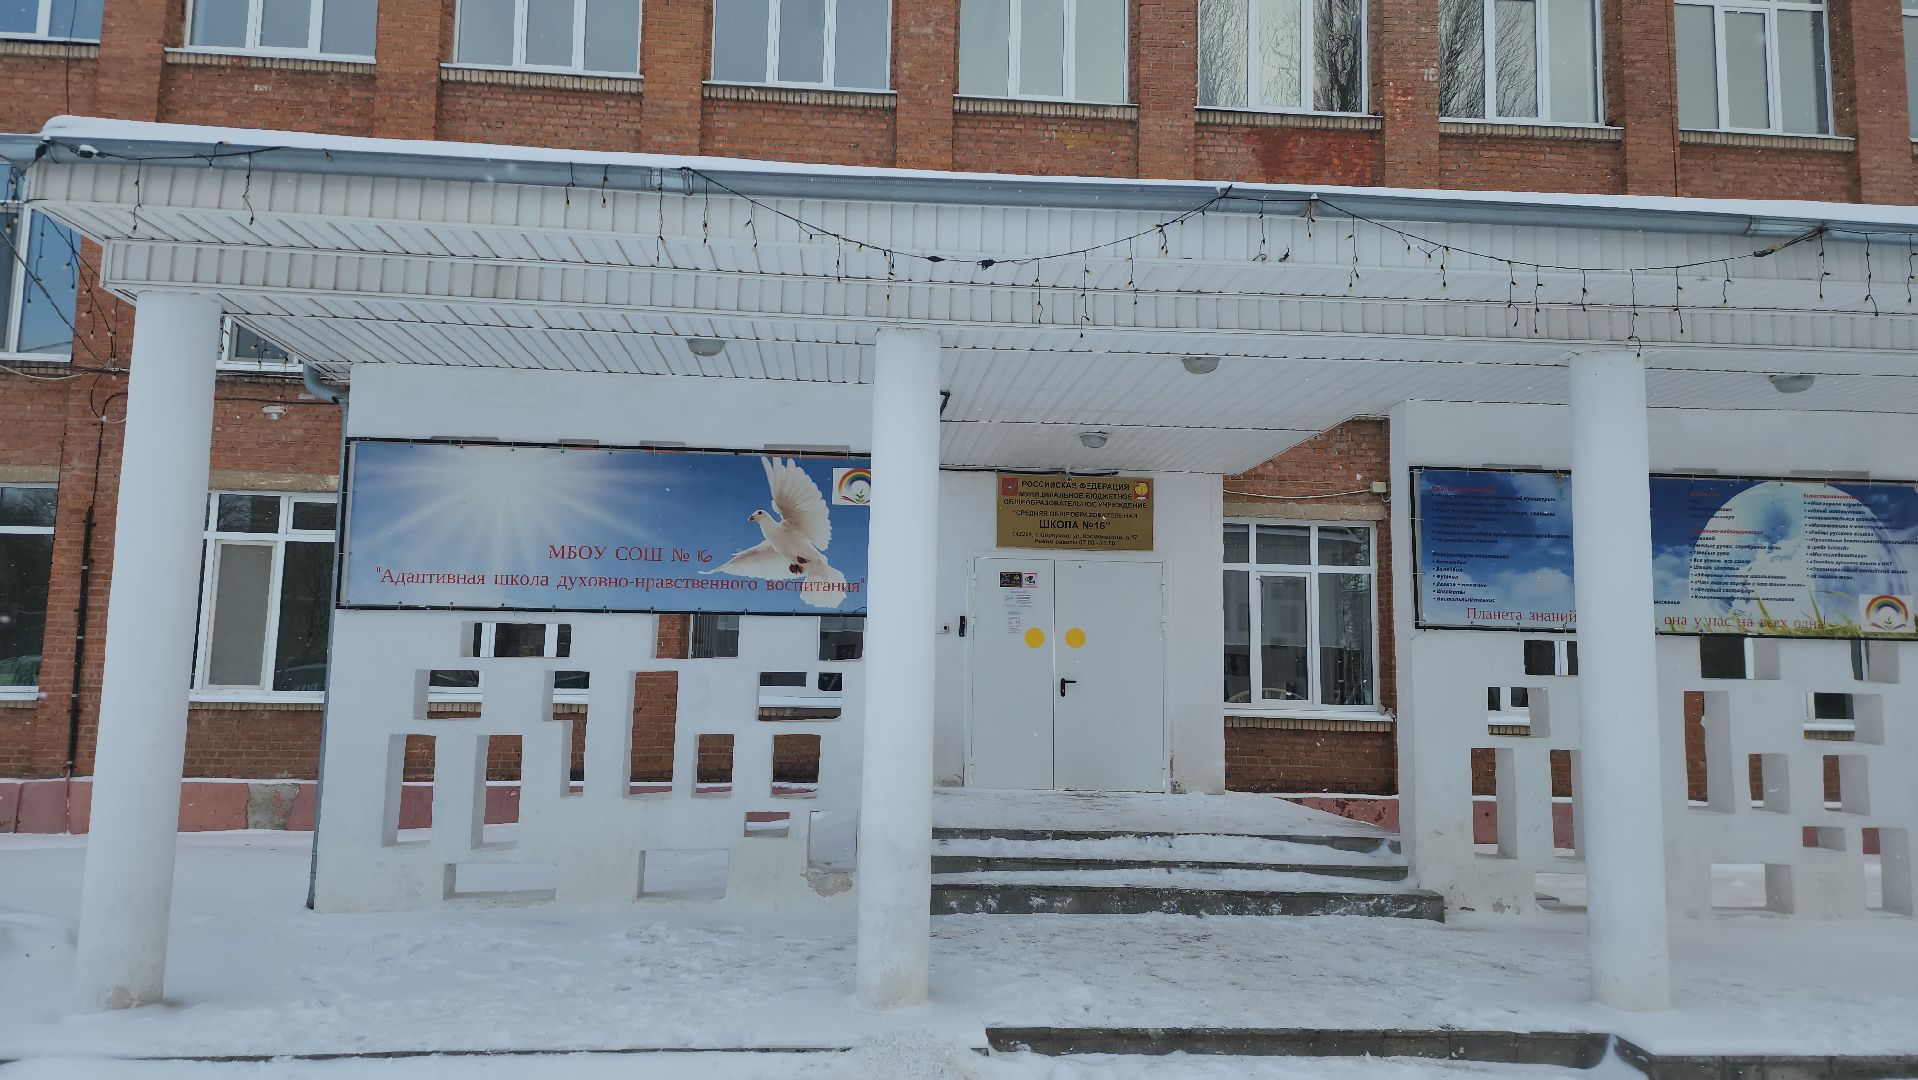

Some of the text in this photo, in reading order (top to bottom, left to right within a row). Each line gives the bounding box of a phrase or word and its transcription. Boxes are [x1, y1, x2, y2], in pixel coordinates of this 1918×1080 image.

[1022, 480, 1130, 490] РОССИЙСКАЯ ФЕДЕРАЦИЯ
[1004, 498, 1096, 507] ОБЩЕОБРАЗОВАТЕЛЬНОЕ
[1040, 520, 1078, 529] ШКОЛА
[549, 544, 608, 560] МБОУ
[616, 546, 662, 562] СОШ
[671, 548, 690, 562] №
[376, 566, 865, 592] "Адаптивная школа духовно-нравственного воспитания"
[1466, 608, 1522, 620] Планета
[1529, 609, 1576, 622] знаний
[1664, 616, 1687, 626] она
[1694, 617, 1702, 628] у
